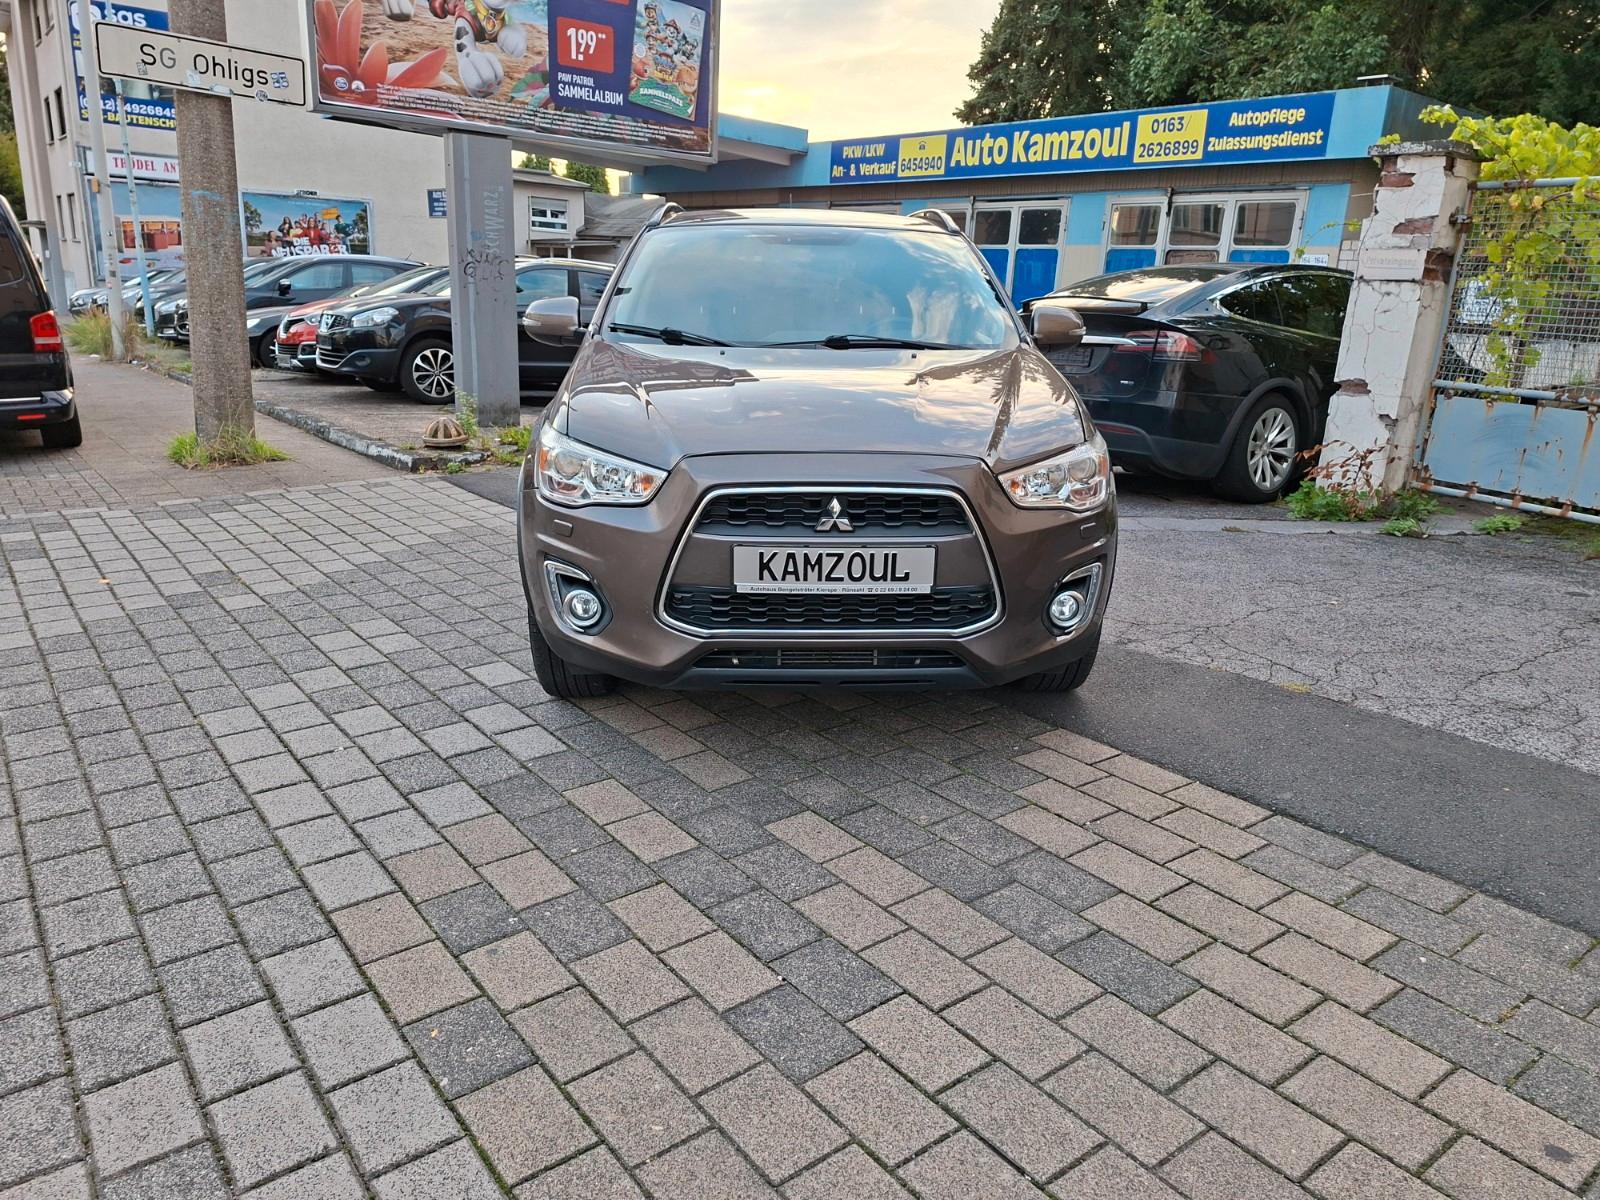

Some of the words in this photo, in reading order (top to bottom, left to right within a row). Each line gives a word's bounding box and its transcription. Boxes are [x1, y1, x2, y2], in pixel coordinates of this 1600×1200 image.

[140, 43, 177, 69] SG
[193, 53, 270, 89] Ohligs
[558, 72, 572, 83] PAW
[573, 74, 595, 87] PATROL
[558, 83, 624, 106] SAMMELALBUM
[1229, 107, 1306, 128] Autopflege
[950, 132, 1008, 168] Auto
[1011, 121, 1131, 163] Kamzoul
[1138, 139, 1199, 159] 2626899
[1207, 128, 1324, 152] Zulassungsdienst
[842, 143, 886, 160] PKW/LKW
[164, 161, 179, 174] AN
[831, 164, 847, 178] An-
[849, 164, 857, 177] &
[859, 160, 897, 176] Verkauf
[900, 156, 943, 173] 6454940
[293, 237, 311, 247] DIE
[757, 551, 911, 583] KAMZOUL
